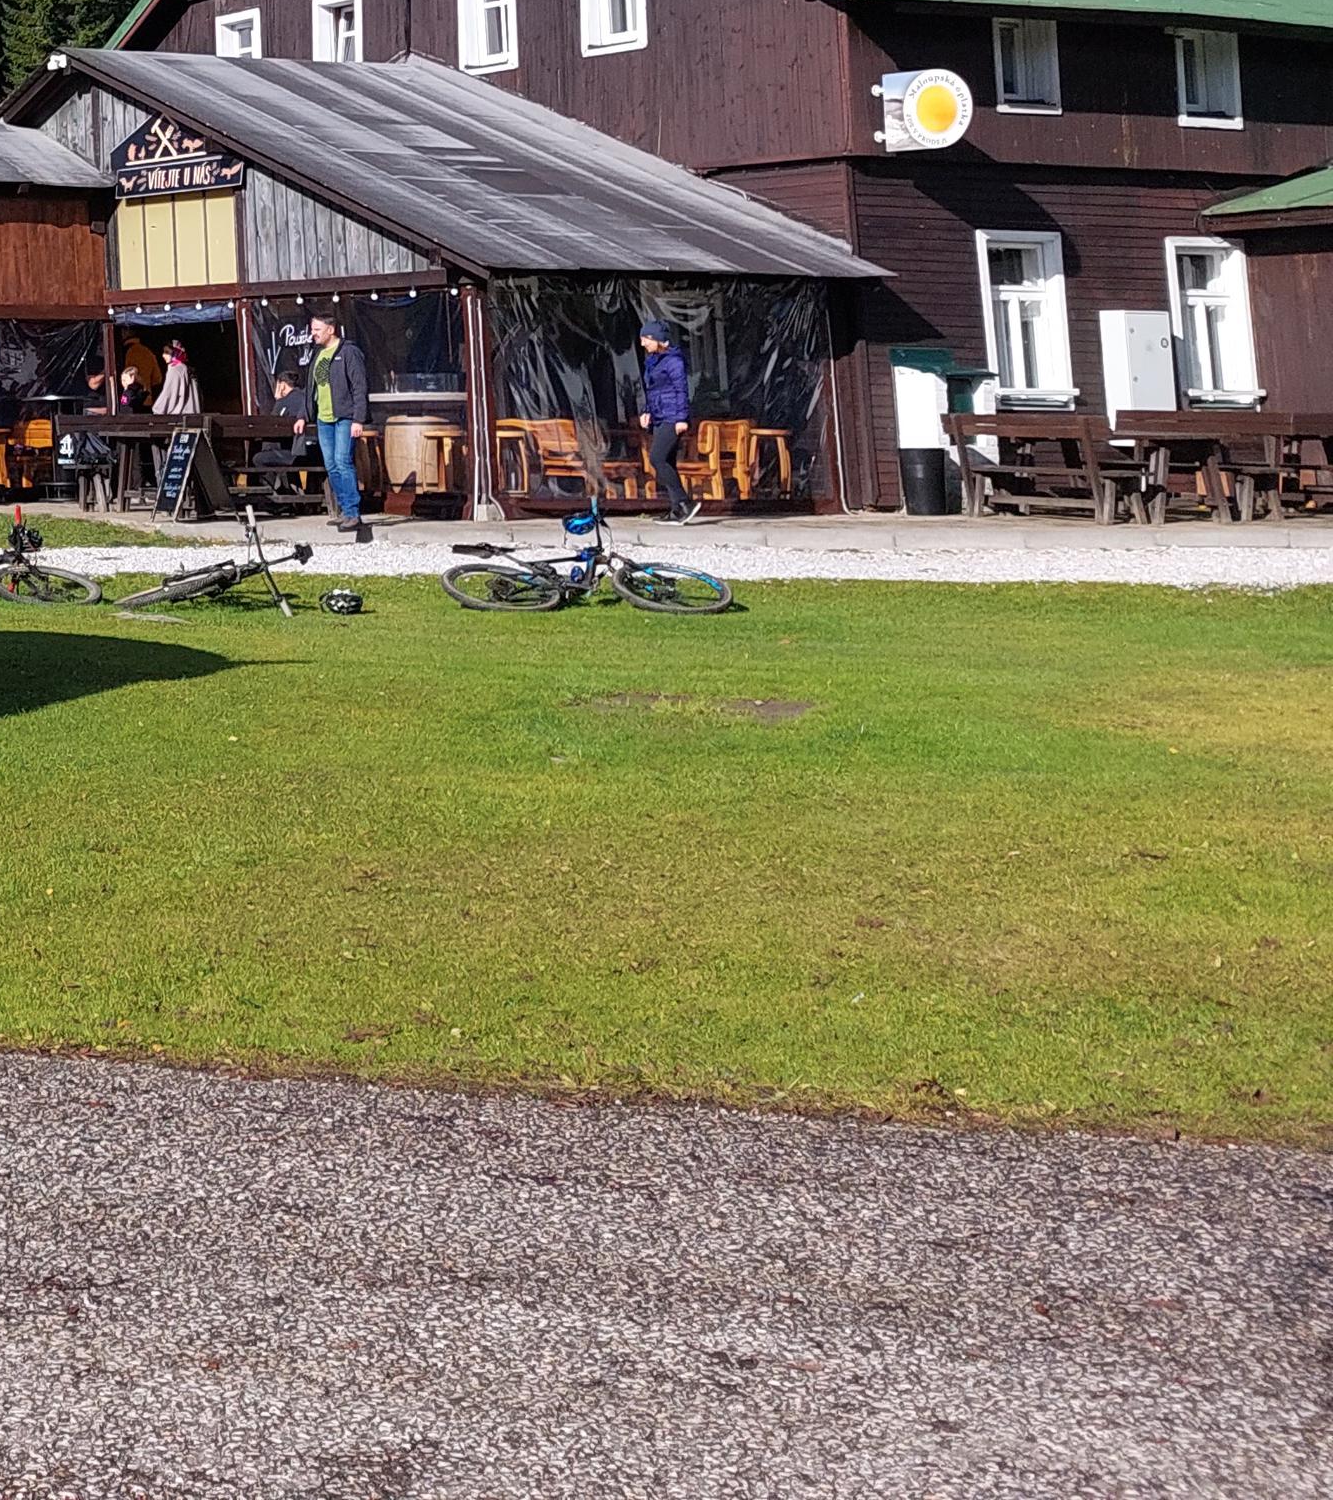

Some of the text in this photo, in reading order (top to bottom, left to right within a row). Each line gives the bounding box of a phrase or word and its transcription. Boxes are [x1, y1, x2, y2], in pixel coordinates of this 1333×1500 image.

[147, 161, 211, 190] VÍTEJTE U NÁS
